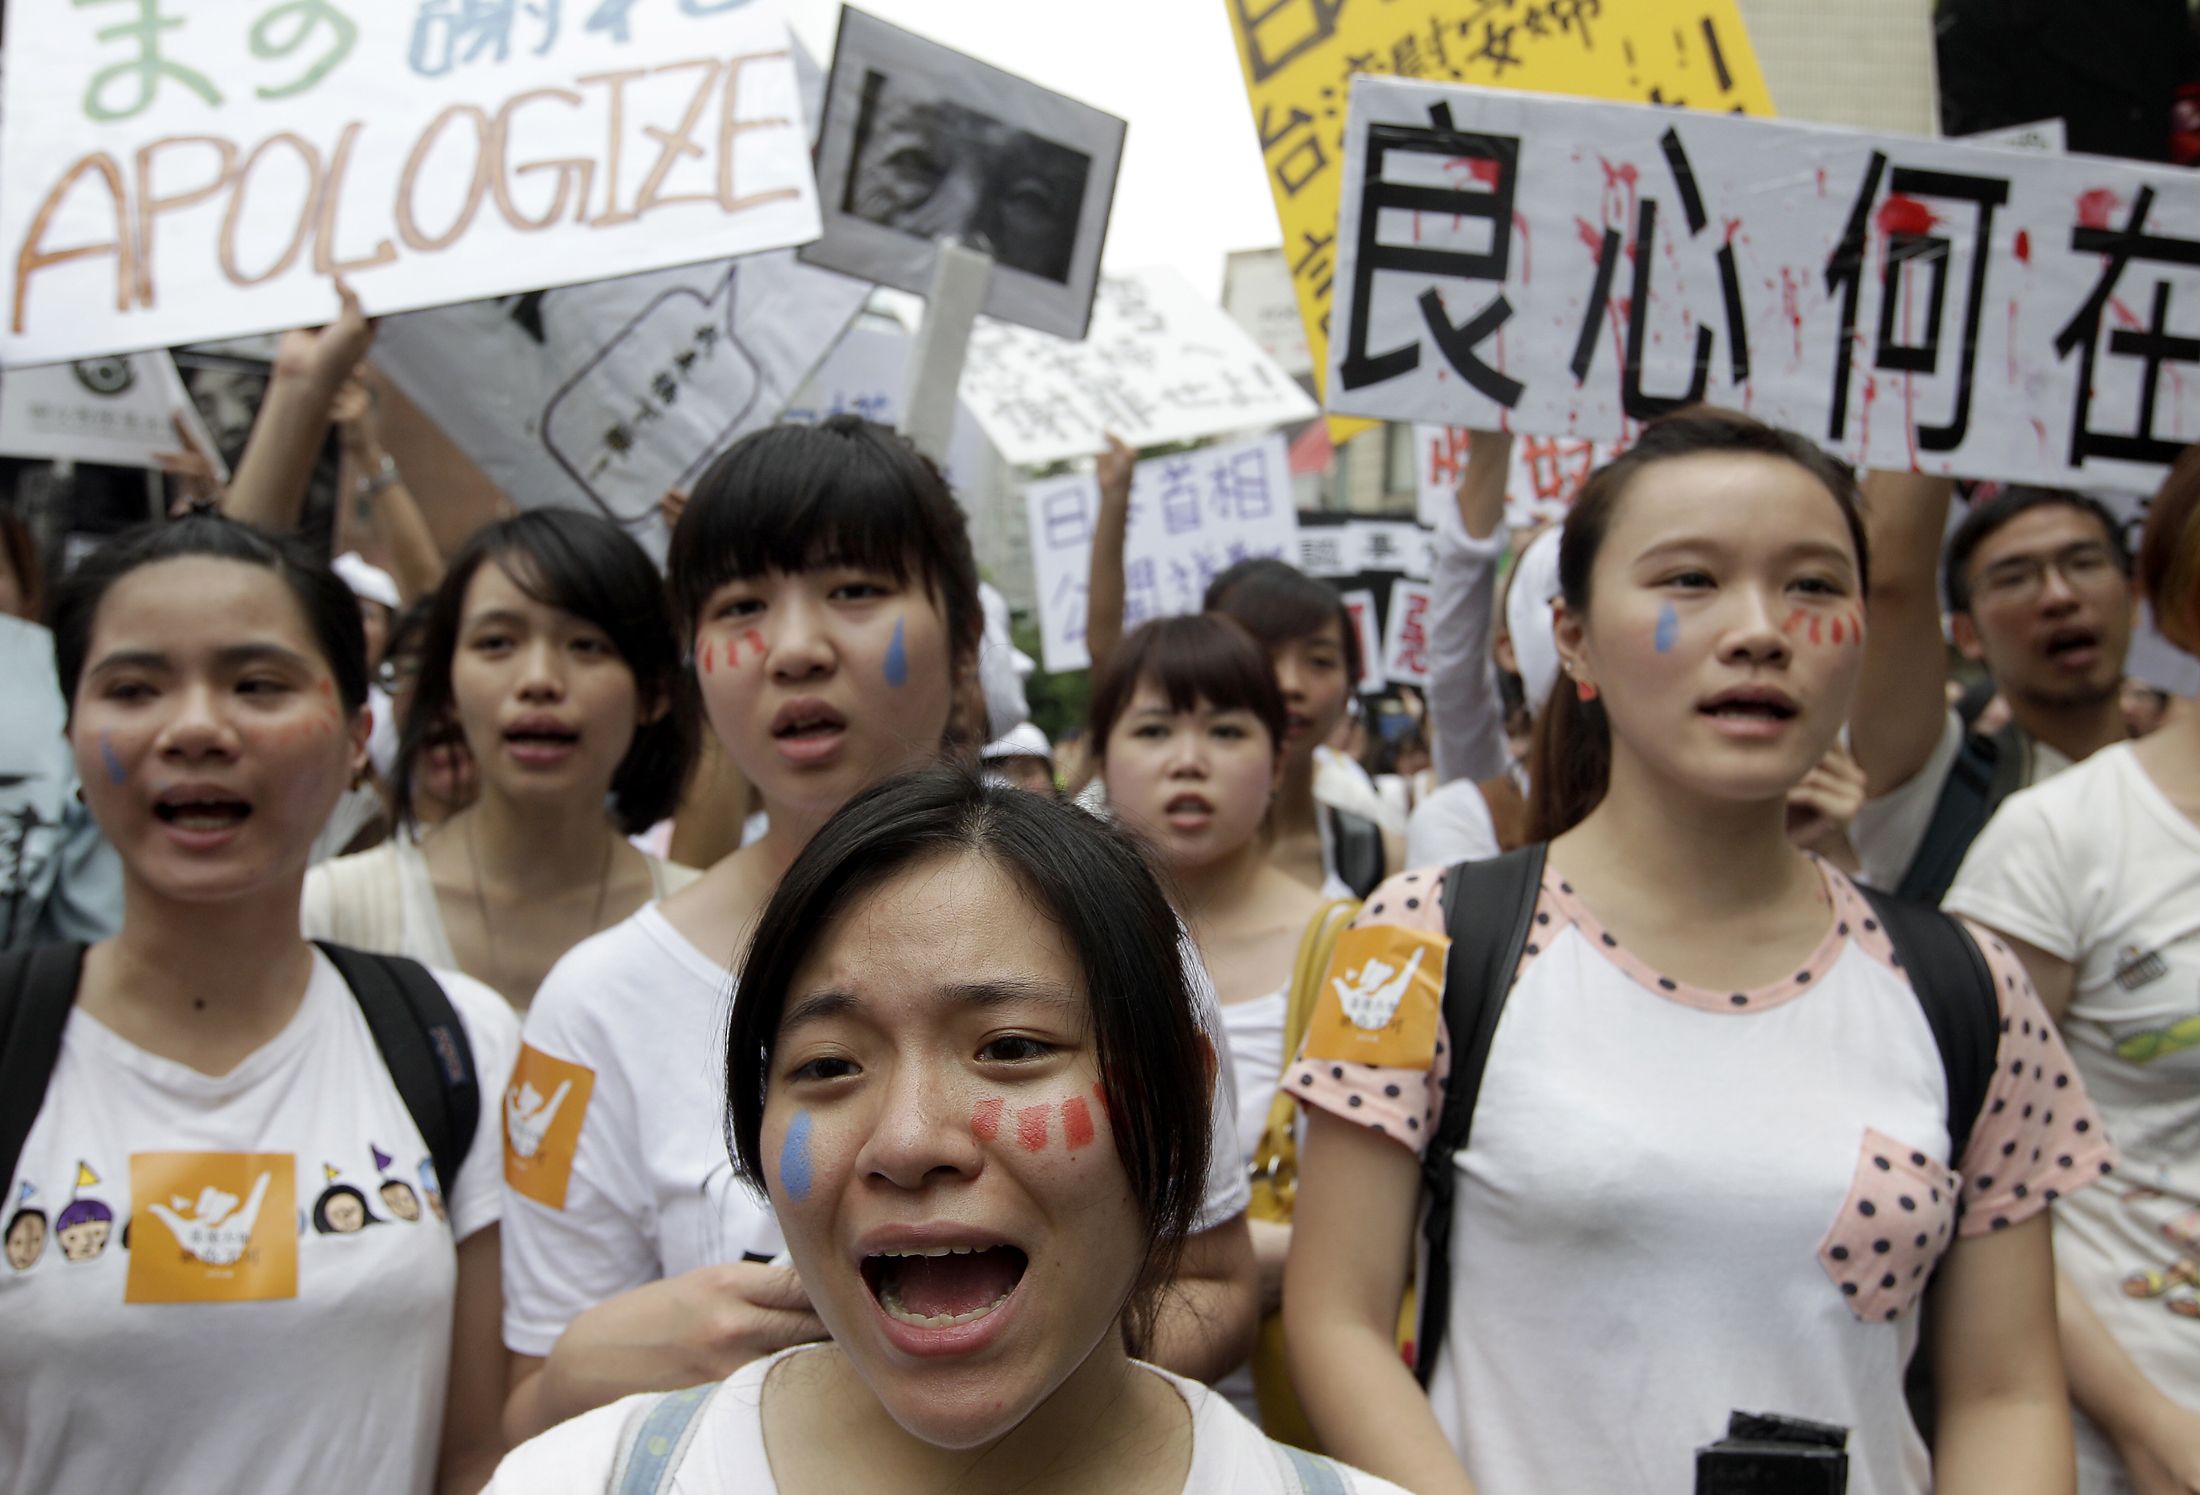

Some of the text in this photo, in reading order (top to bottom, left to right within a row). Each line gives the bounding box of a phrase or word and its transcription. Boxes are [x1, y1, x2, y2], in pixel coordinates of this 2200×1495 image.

[12, 50, 801, 335] APOLOGIZE
[1340, 100, 2200, 469] 良心何在
[1042, 448, 1273, 550] 日首相
